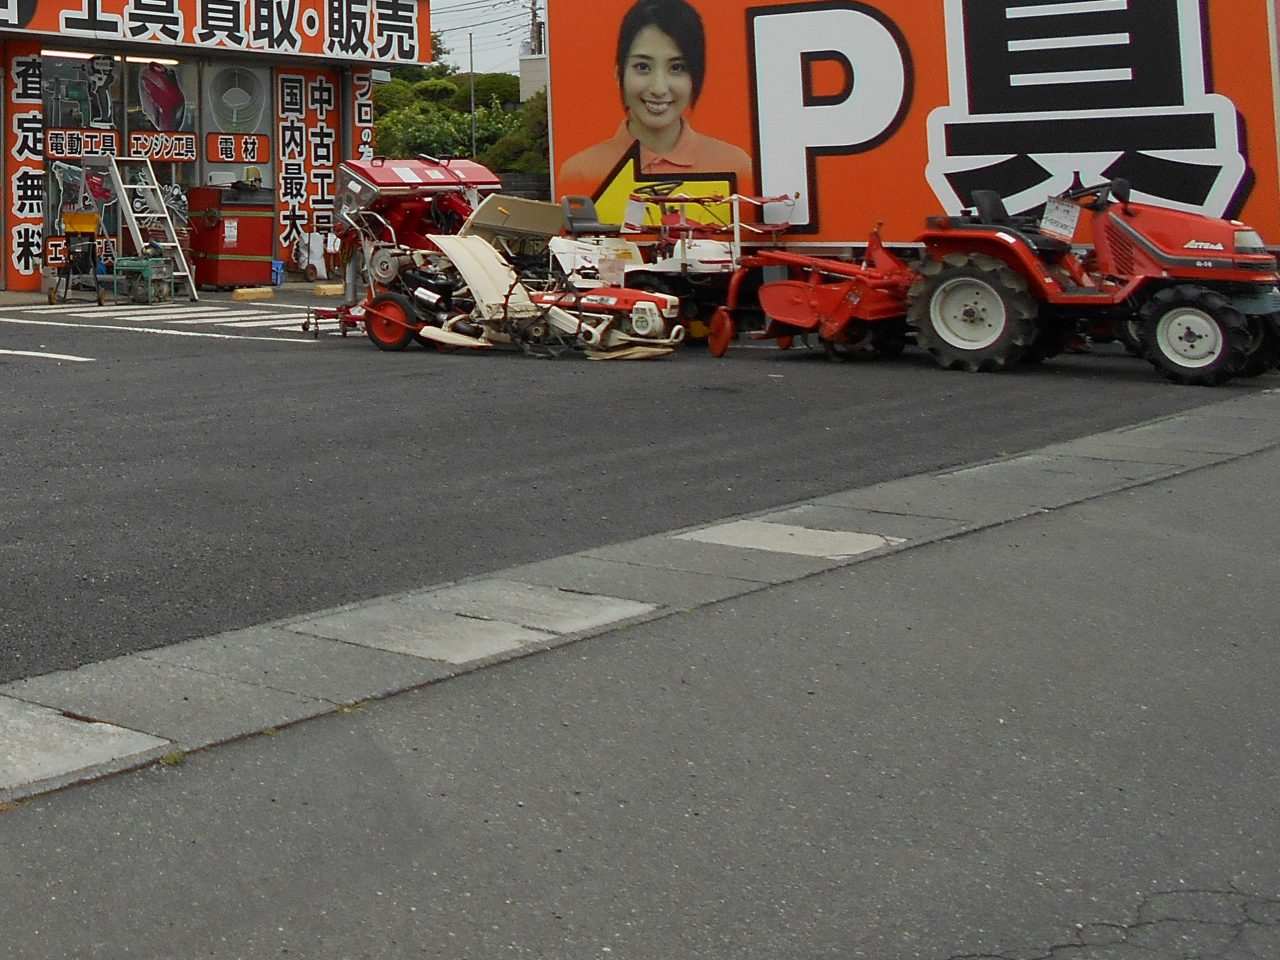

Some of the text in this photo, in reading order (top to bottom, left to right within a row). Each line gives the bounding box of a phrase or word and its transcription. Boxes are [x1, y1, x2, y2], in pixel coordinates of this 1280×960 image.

[752, 8, 908, 226] P
[47, 132, 117, 157] 電動工具
[131, 134, 197, 160] エンジン工具
[218, 136, 258, 161] 電材
[11, 57, 43, 275] 査定無料
